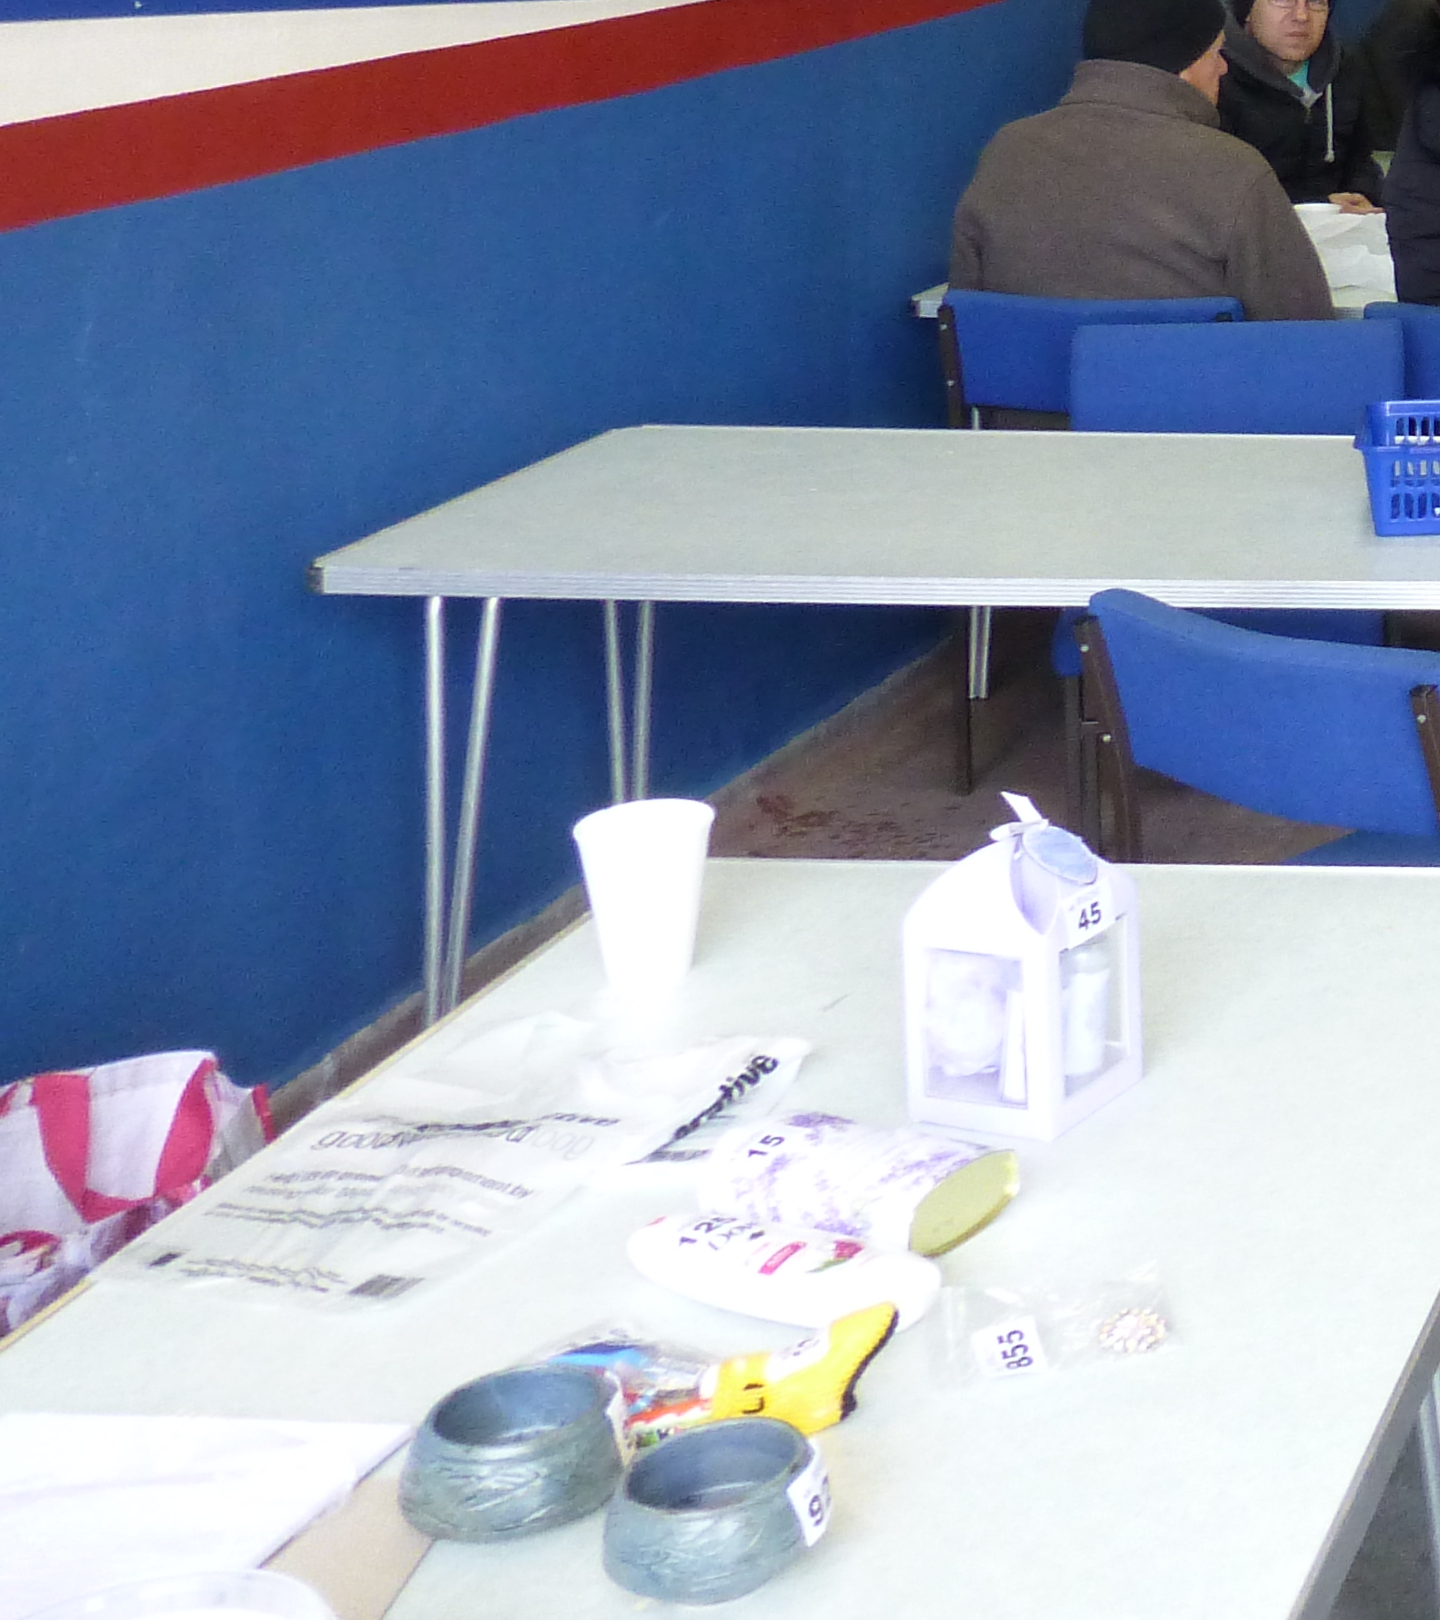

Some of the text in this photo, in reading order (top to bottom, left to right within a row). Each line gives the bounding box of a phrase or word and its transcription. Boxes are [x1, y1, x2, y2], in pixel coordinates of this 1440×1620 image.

[1078, 901, 1101, 931] 45
[747, 1133, 786, 1158] 15
[996, 1329, 1034, 1370] 855
